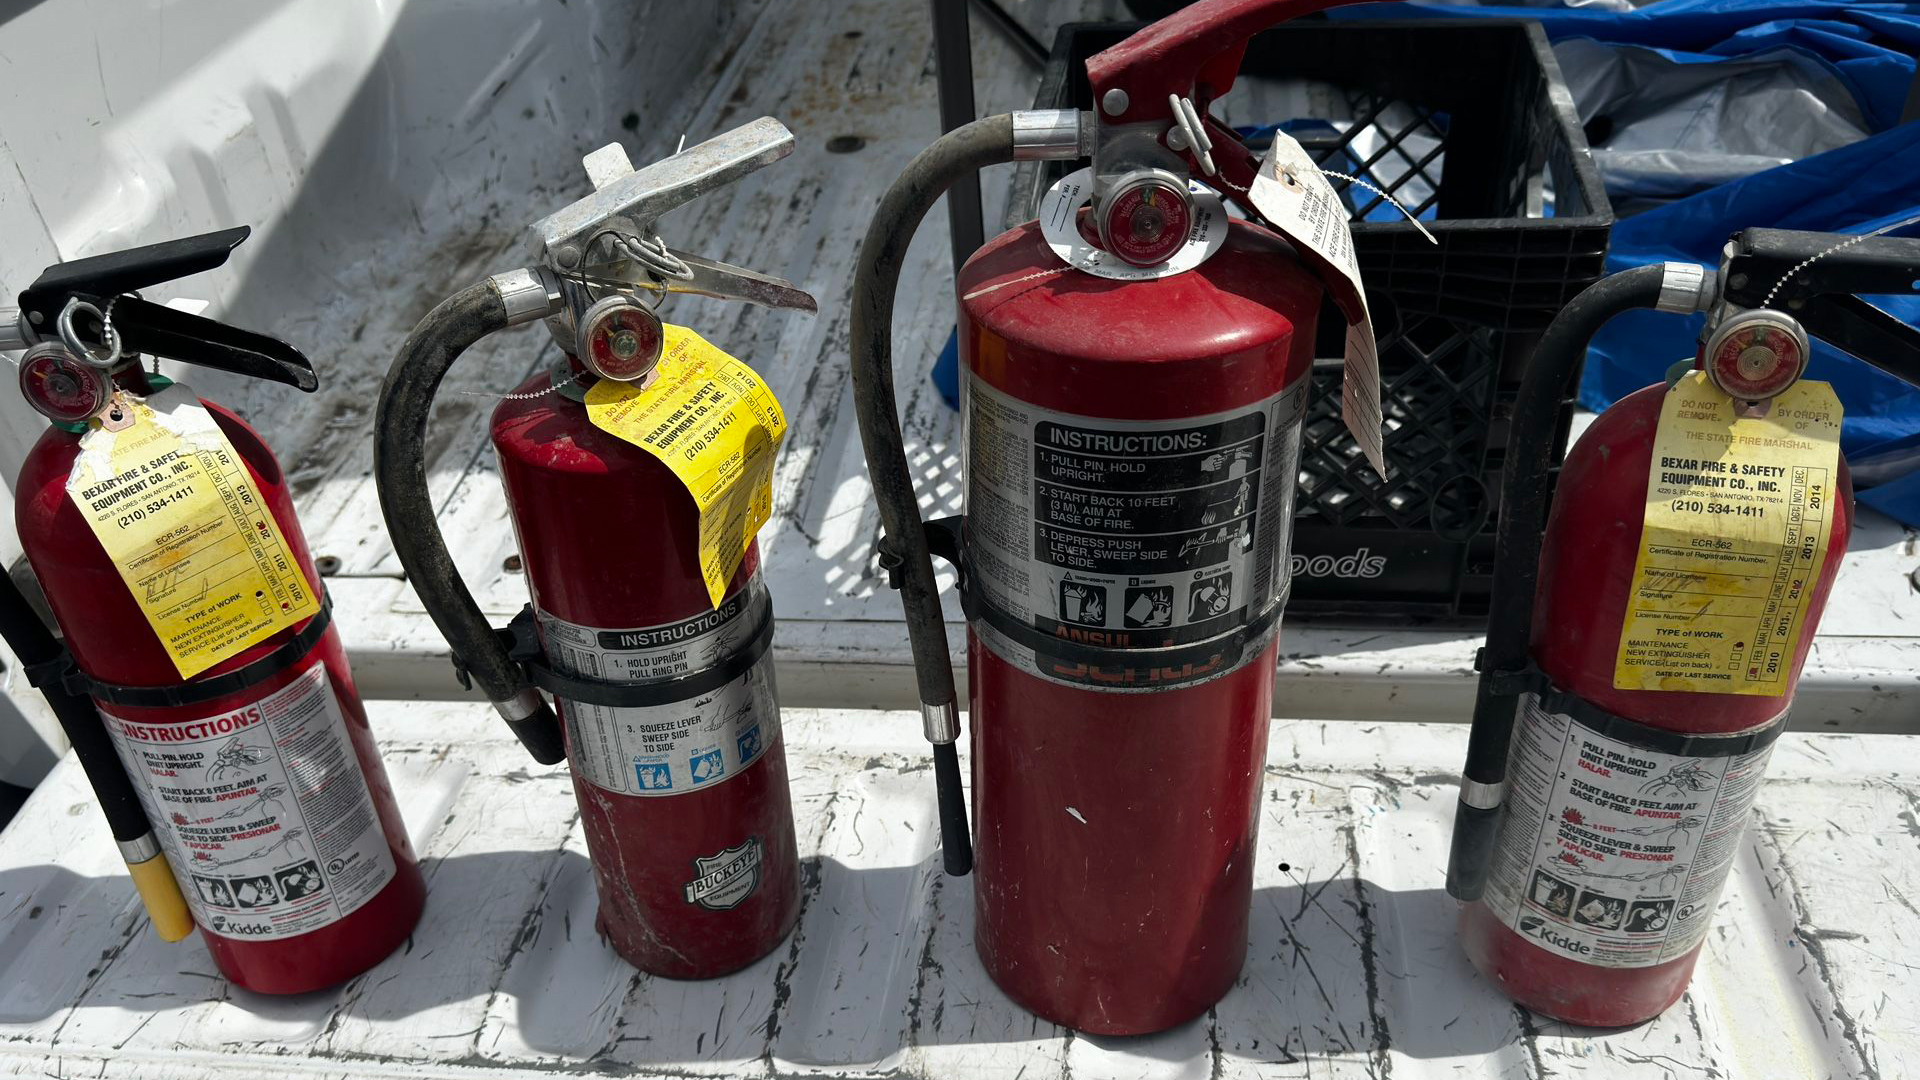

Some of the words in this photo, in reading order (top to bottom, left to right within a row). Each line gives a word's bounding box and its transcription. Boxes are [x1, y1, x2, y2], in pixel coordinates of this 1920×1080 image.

[736, 371, 756, 389] 2014
[644, 423, 670, 444] BEXAR
[667, 409, 686, 425] FIRE
[683, 403, 693, 411] &
[689, 382, 716, 405] SAFETY
[1681, 399, 1695, 409] DO
[1697, 400, 1719, 411] NOT
[1778, 408, 1790, 418] BY
[1793, 410, 1829, 421] ORDER
[656, 414, 698, 450] EQUIPMENT
[694, 405, 715, 417] CO.,
[709, 391, 728, 404] INC.
[766, 406, 780, 428] 2013
[1795, 421, 1809, 430] OF
[684, 439, 707, 461] (210)
[703, 411, 737, 443] 534-1411
[1050, 427, 1207, 453] INSTRUCTIONS:
[1686, 431, 1705, 440] THE
[1706, 432, 1736, 443] STATE
[1739, 436, 1761, 446] FIRE
[1764, 438, 1813, 450] MARSHAL
[718, 451, 741, 475] ECR-562
[1039, 451, 1048, 462] 1.
[1051, 454, 1080, 468] PULL
[1084, 460, 1107, 471] PIN.
[1110, 462, 1146, 473] HOLD
[1661, 456, 1698, 470] BEXAR
[1701, 460, 1726, 472] FIRE
[1730, 463, 1738, 474] &
[1742, 464, 1786, 478] SAFETY
[82, 479, 117, 501] BEXAR
[117, 468, 140, 486] FIRE
[140, 464, 150, 473] &
[149, 450, 181, 470] SAFET
[1051, 466, 1105, 482] UPRIGHT.
[1661, 472, 1726, 488] EQUIPMENT
[1730, 478, 1753, 492] CO.,
[1758, 480, 1781, 492] INC.
[92, 479, 148, 512] EQUIPMENT
[148, 473, 172, 485] CO.,
[171, 461, 193, 475] INC.
[236, 484, 252, 505] 2013
[1039, 486, 1048, 496] 2.
[1050, 488, 1088, 503] START
[1090, 495, 1125, 507] BACK
[1128, 498, 1142, 507] 10
[1144, 496, 1176, 507] FEET
[1810, 485, 1821, 509] 2014
[117, 509, 146, 530] (210)
[146, 485, 194, 514] 534-1411
[1050, 499, 1060, 511] (3
[1082, 506, 1104, 517] AIM
[1106, 508, 1122, 518] AT
[1672, 499, 1703, 515] (210)
[1707, 503, 1764, 518] 534-1411
[1050, 510, 1081, 525] BASE
[1084, 517, 1101, 527] OF
[1104, 519, 1135, 529] FIRE.
[156, 525, 190, 546] ECR-562
[1039, 528, 1048, 538] 3.
[1050, 531, 1105, 548] DEPRESS
[1108, 540, 1142, 550] PUSH
[1691, 539, 1733, 550] ECR-562
[1093, 549, 1137, 560] SWEEP
[1139, 550, 1168, 560] SIDE
[1649, 546, 1685, 556] Certificate
[1695, 551, 1737, 562] Registration
[1801, 536, 1815, 560] 2013
[273, 553, 288, 571] 2011
[1050, 552, 1065, 562] TO
[1067, 556, 1097, 568] SIDE.
[1291, 547, 1387, 578] oods
[289, 583, 303, 601] 2010
[185, 610, 207, 624] TYPE
[208, 605, 217, 613] of
[217, 593, 243, 608] WORK
[171, 615, 222, 643] MAINTENANCE
[620, 602, 736, 647] INSTRUCTIONS
[1656, 628, 1680, 637] TYPE
[1694, 631, 1724, 639] WORK
[1628, 640, 1688, 649] MAINTENANCE
[1648, 650, 1710, 659] EXTINGUISHER
[614, 659, 623, 668] 1.
[628, 657, 650, 668] HOLD
[652, 651, 687, 666] UPRIGHT
[630, 669, 651, 678] PULL
[653, 665, 672, 676] RING
[674, 661, 688, 673] PIN
[1624, 658, 1661, 666] SERVICE
[1691, 661, 1712, 669] back)
[1767, 652, 1779, 673] 2010
[626, 725, 636, 734] 3.
[640, 721, 676, 733] SQUEEZE
[677, 715, 702, 729] LEVER
[642, 733, 670, 743] SWEEP
[671, 729, 690, 740] SIDE
[644, 745, 655, 753] TO
[656, 742, 675, 752] SIDE
[1582, 741, 1605, 757] PULL
[1606, 751, 1626, 764] PIN.
[1627, 759, 1656, 770] HOLD
[1578, 759, 1612, 779] HALAR.
[1580, 750, 1604, 765] UNIT
[1604, 760, 1648, 778] UPRIGHT.
[1569, 787, 1593, 803] BASE
[1594, 798, 1609, 807] OF
[1609, 802, 1633, 815] FIRE.
[1571, 778, 1601, 796] START
[1602, 789, 1628, 805] BACK
[1629, 798, 1637, 806] 8
[1638, 800, 1663, 810] FEET.
[1663, 802, 1683, 810] AIM
[1685, 802, 1698, 810] AT
[1557, 828, 1579, 844] SIDE
[1579, 838, 1593, 848] TO
[1594, 845, 1618, 856] SIDE.
[1620, 850, 1675, 861] PRESIONAR
[1560, 820, 1601, 843] SQUEEZE
[1602, 836, 1632, 850] LEVER
[1643, 845, 1676, 853] SWEEP
[1564, 841, 1605, 862] APLICAR.
[695, 849, 755, 894] BUCKEYE
[227, 922, 272, 935] Kidde
[1540, 927, 1590, 955] Kidde
